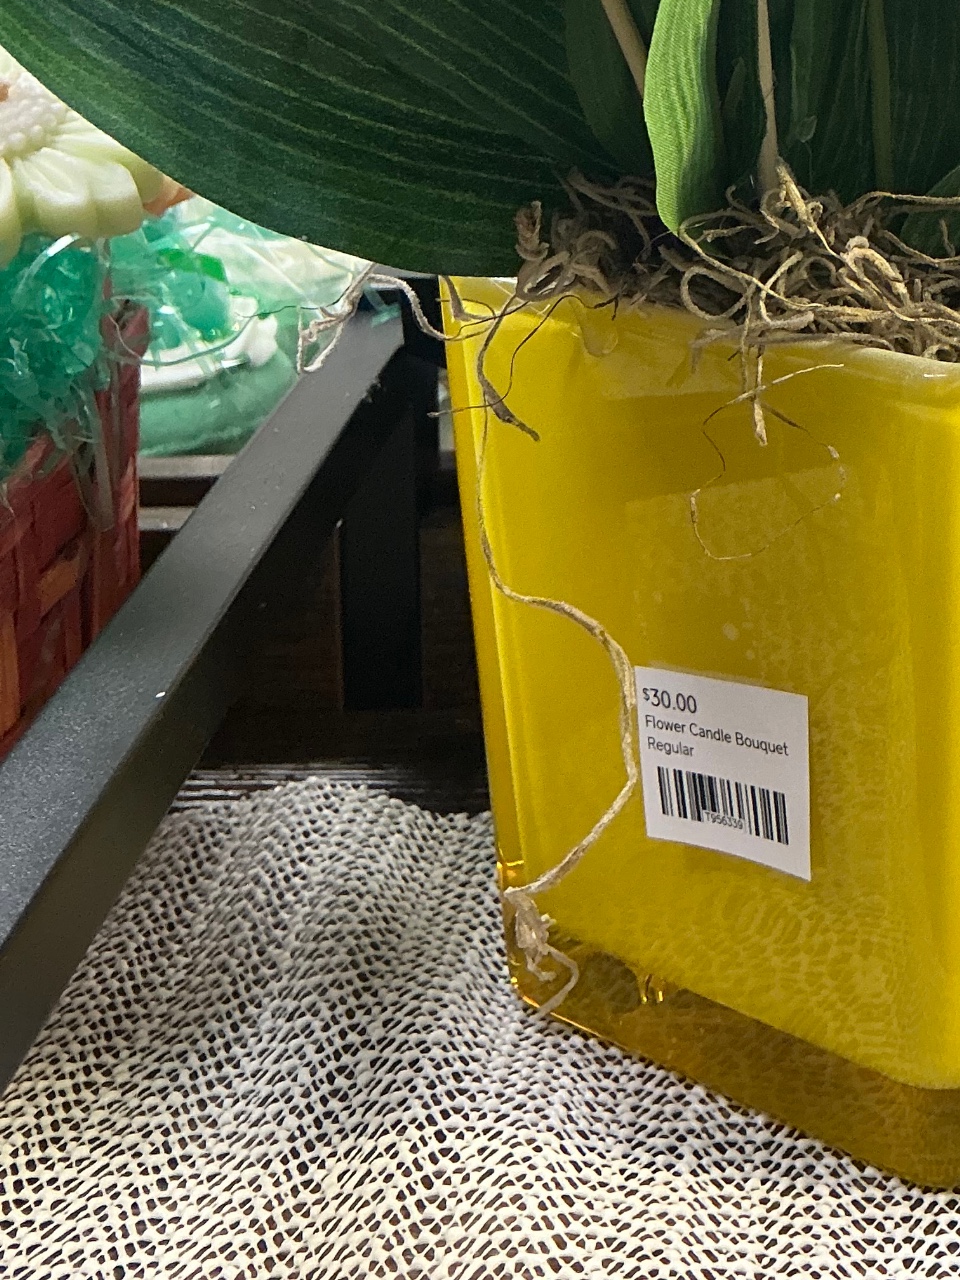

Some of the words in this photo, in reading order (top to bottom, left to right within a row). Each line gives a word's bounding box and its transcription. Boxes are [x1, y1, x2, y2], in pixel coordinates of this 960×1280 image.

[642, 687, 698, 714] $30.00
[645, 714, 687, 734] Flower
[689, 723, 732, 744] Candle
[735, 732, 789, 757] Bouquet
[647, 737, 694, 757] Regular
